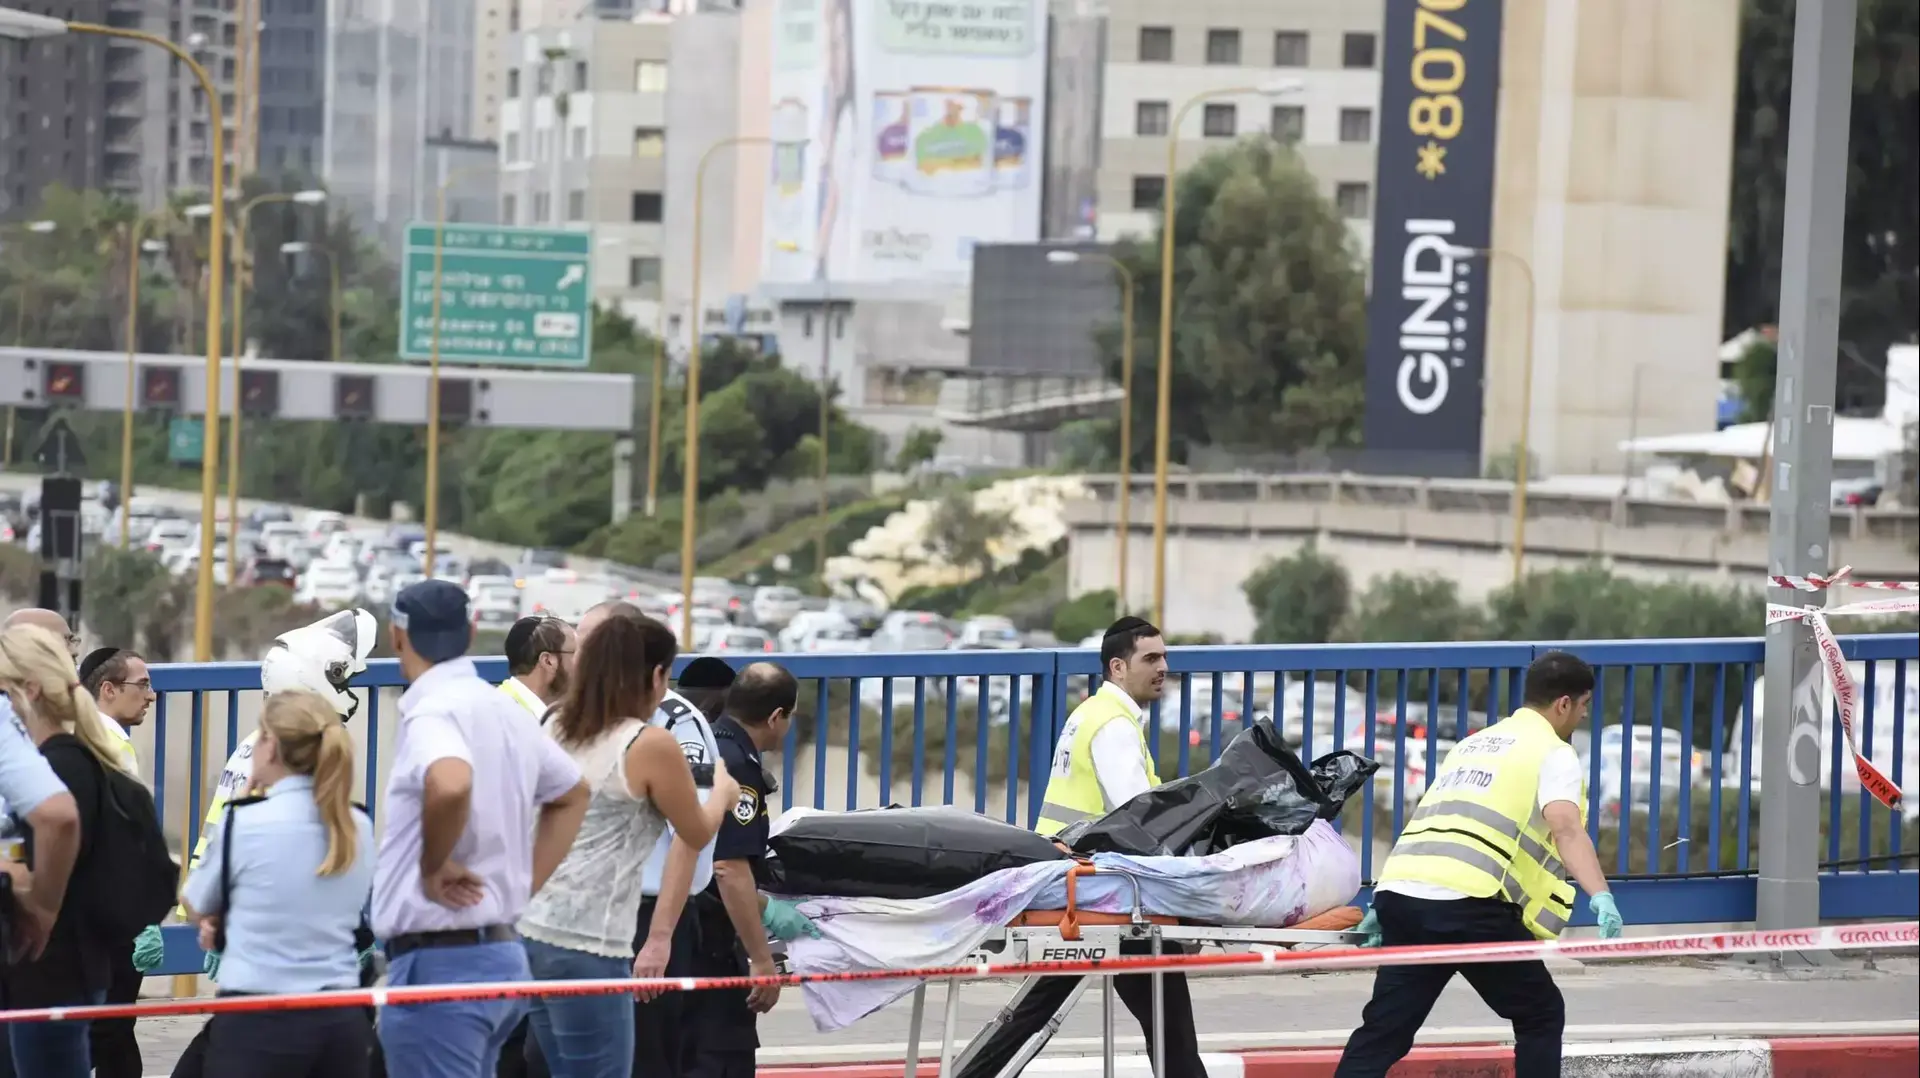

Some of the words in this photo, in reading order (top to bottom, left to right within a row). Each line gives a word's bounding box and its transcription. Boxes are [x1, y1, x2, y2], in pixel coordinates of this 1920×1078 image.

[1408, 0, 1467, 181] 807
[1396, 219, 1456, 415] GINDI
[1870, 779, 1890, 796] אין
[1732, 934, 1758, 949] אין
[1764, 933, 1816, 946] מעבר
[1042, 948, 1106, 960] FERNO
